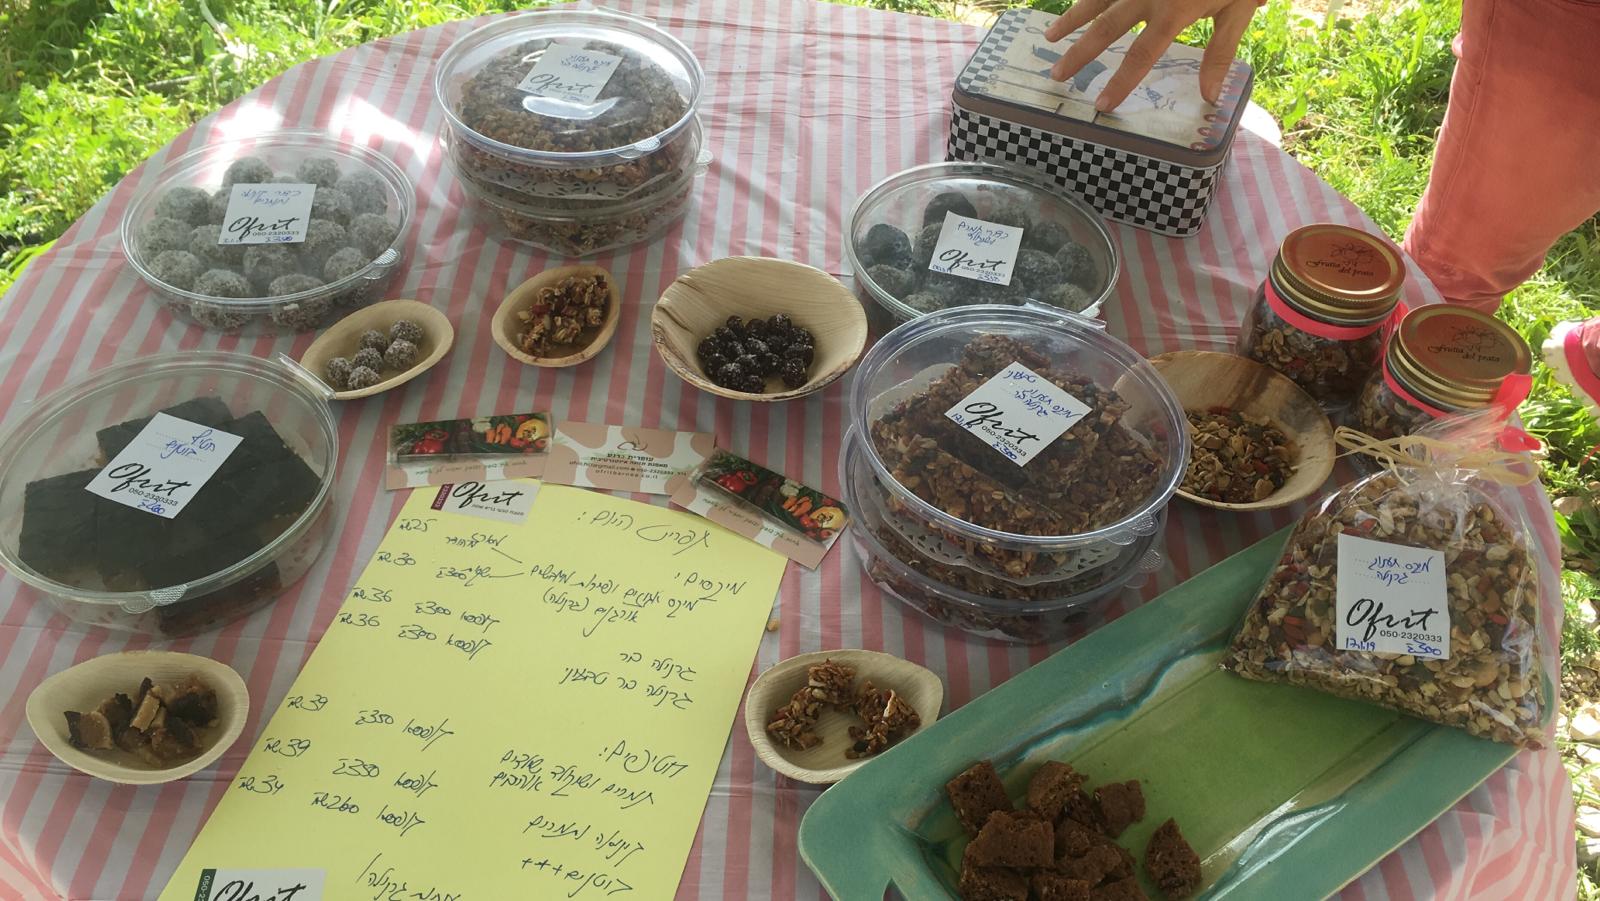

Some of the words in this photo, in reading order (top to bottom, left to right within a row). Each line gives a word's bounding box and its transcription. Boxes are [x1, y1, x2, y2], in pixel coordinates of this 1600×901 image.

[530, 73, 597, 93] Ofrit
[228, 216, 300, 241] Ofrit
[939, 249, 1007, 274] Ofrit
[965, 402, 1041, 445] Ofrit
[108, 462, 193, 496] Ofrit
[452, 481, 525, 509] Ofrit
[1346, 598, 1440, 643] Ofrit
